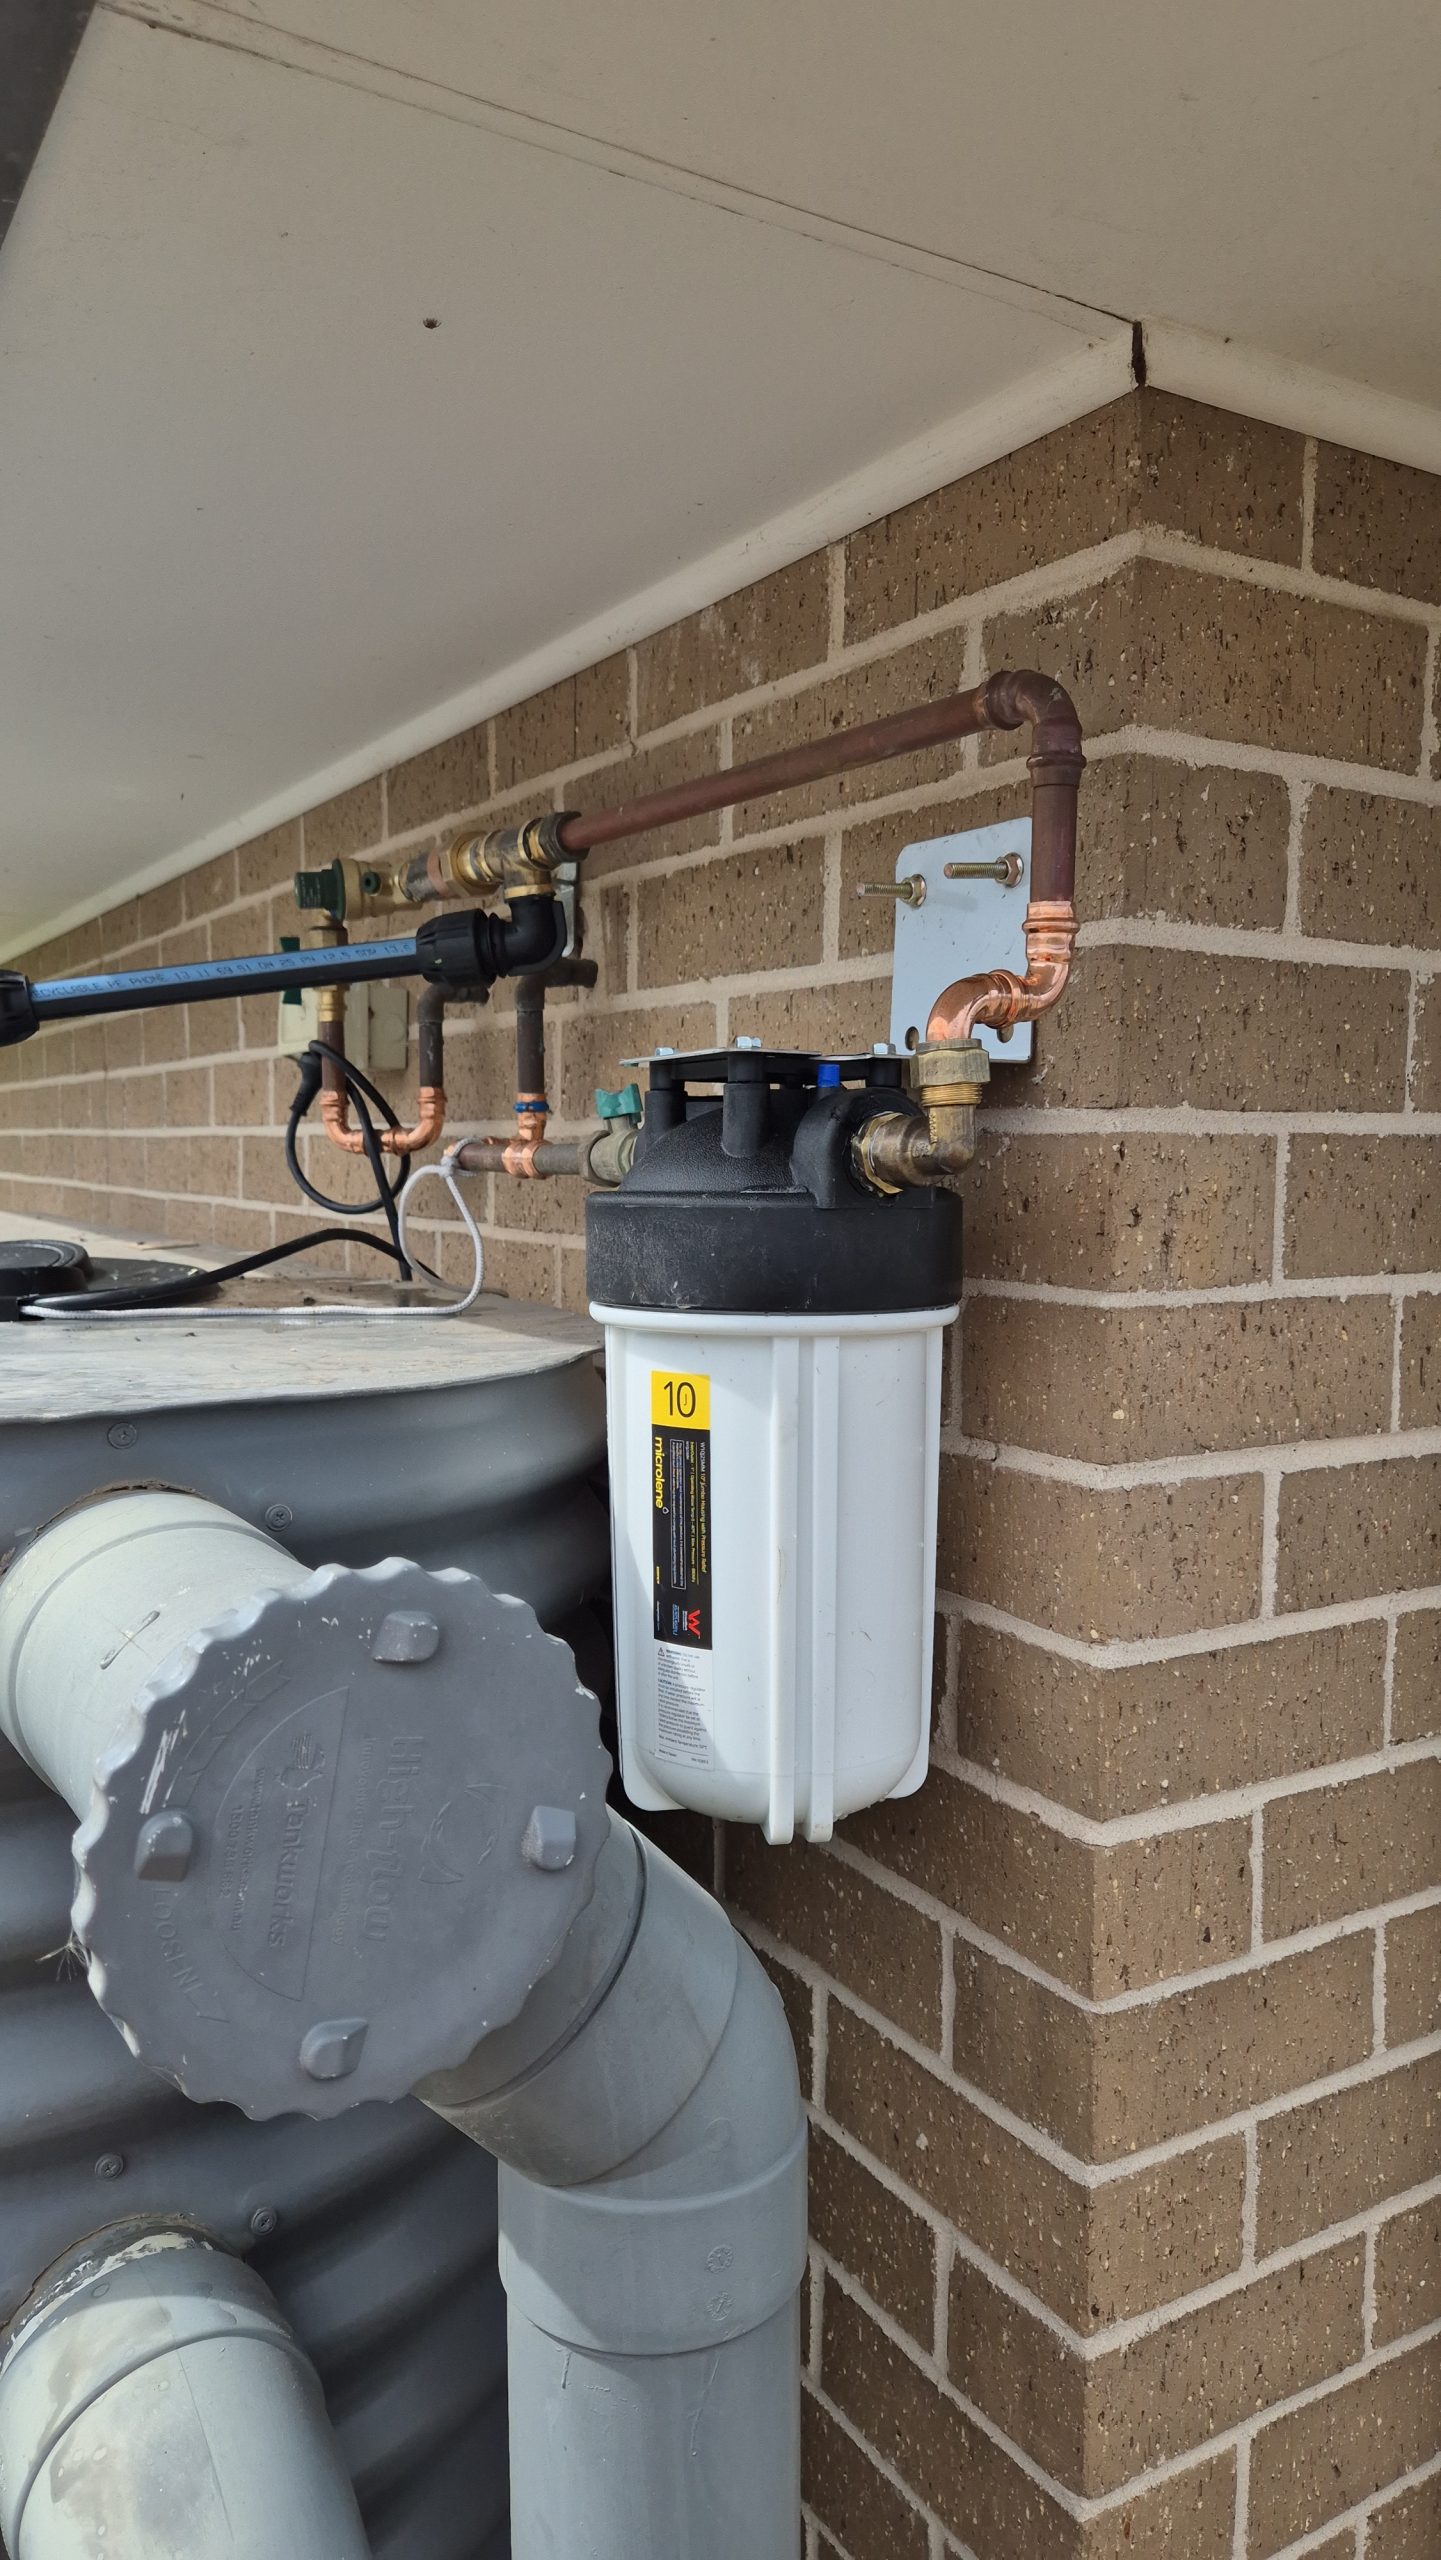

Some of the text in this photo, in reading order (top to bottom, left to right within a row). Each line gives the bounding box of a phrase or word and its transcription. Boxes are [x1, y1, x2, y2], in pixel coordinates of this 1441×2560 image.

[663, 1381, 696, 1418] 10
[655, 1436, 665, 1508] microlene
[267, 1798, 314, 1948] Tankworks
[362, 1735, 425, 1944] High-flow
